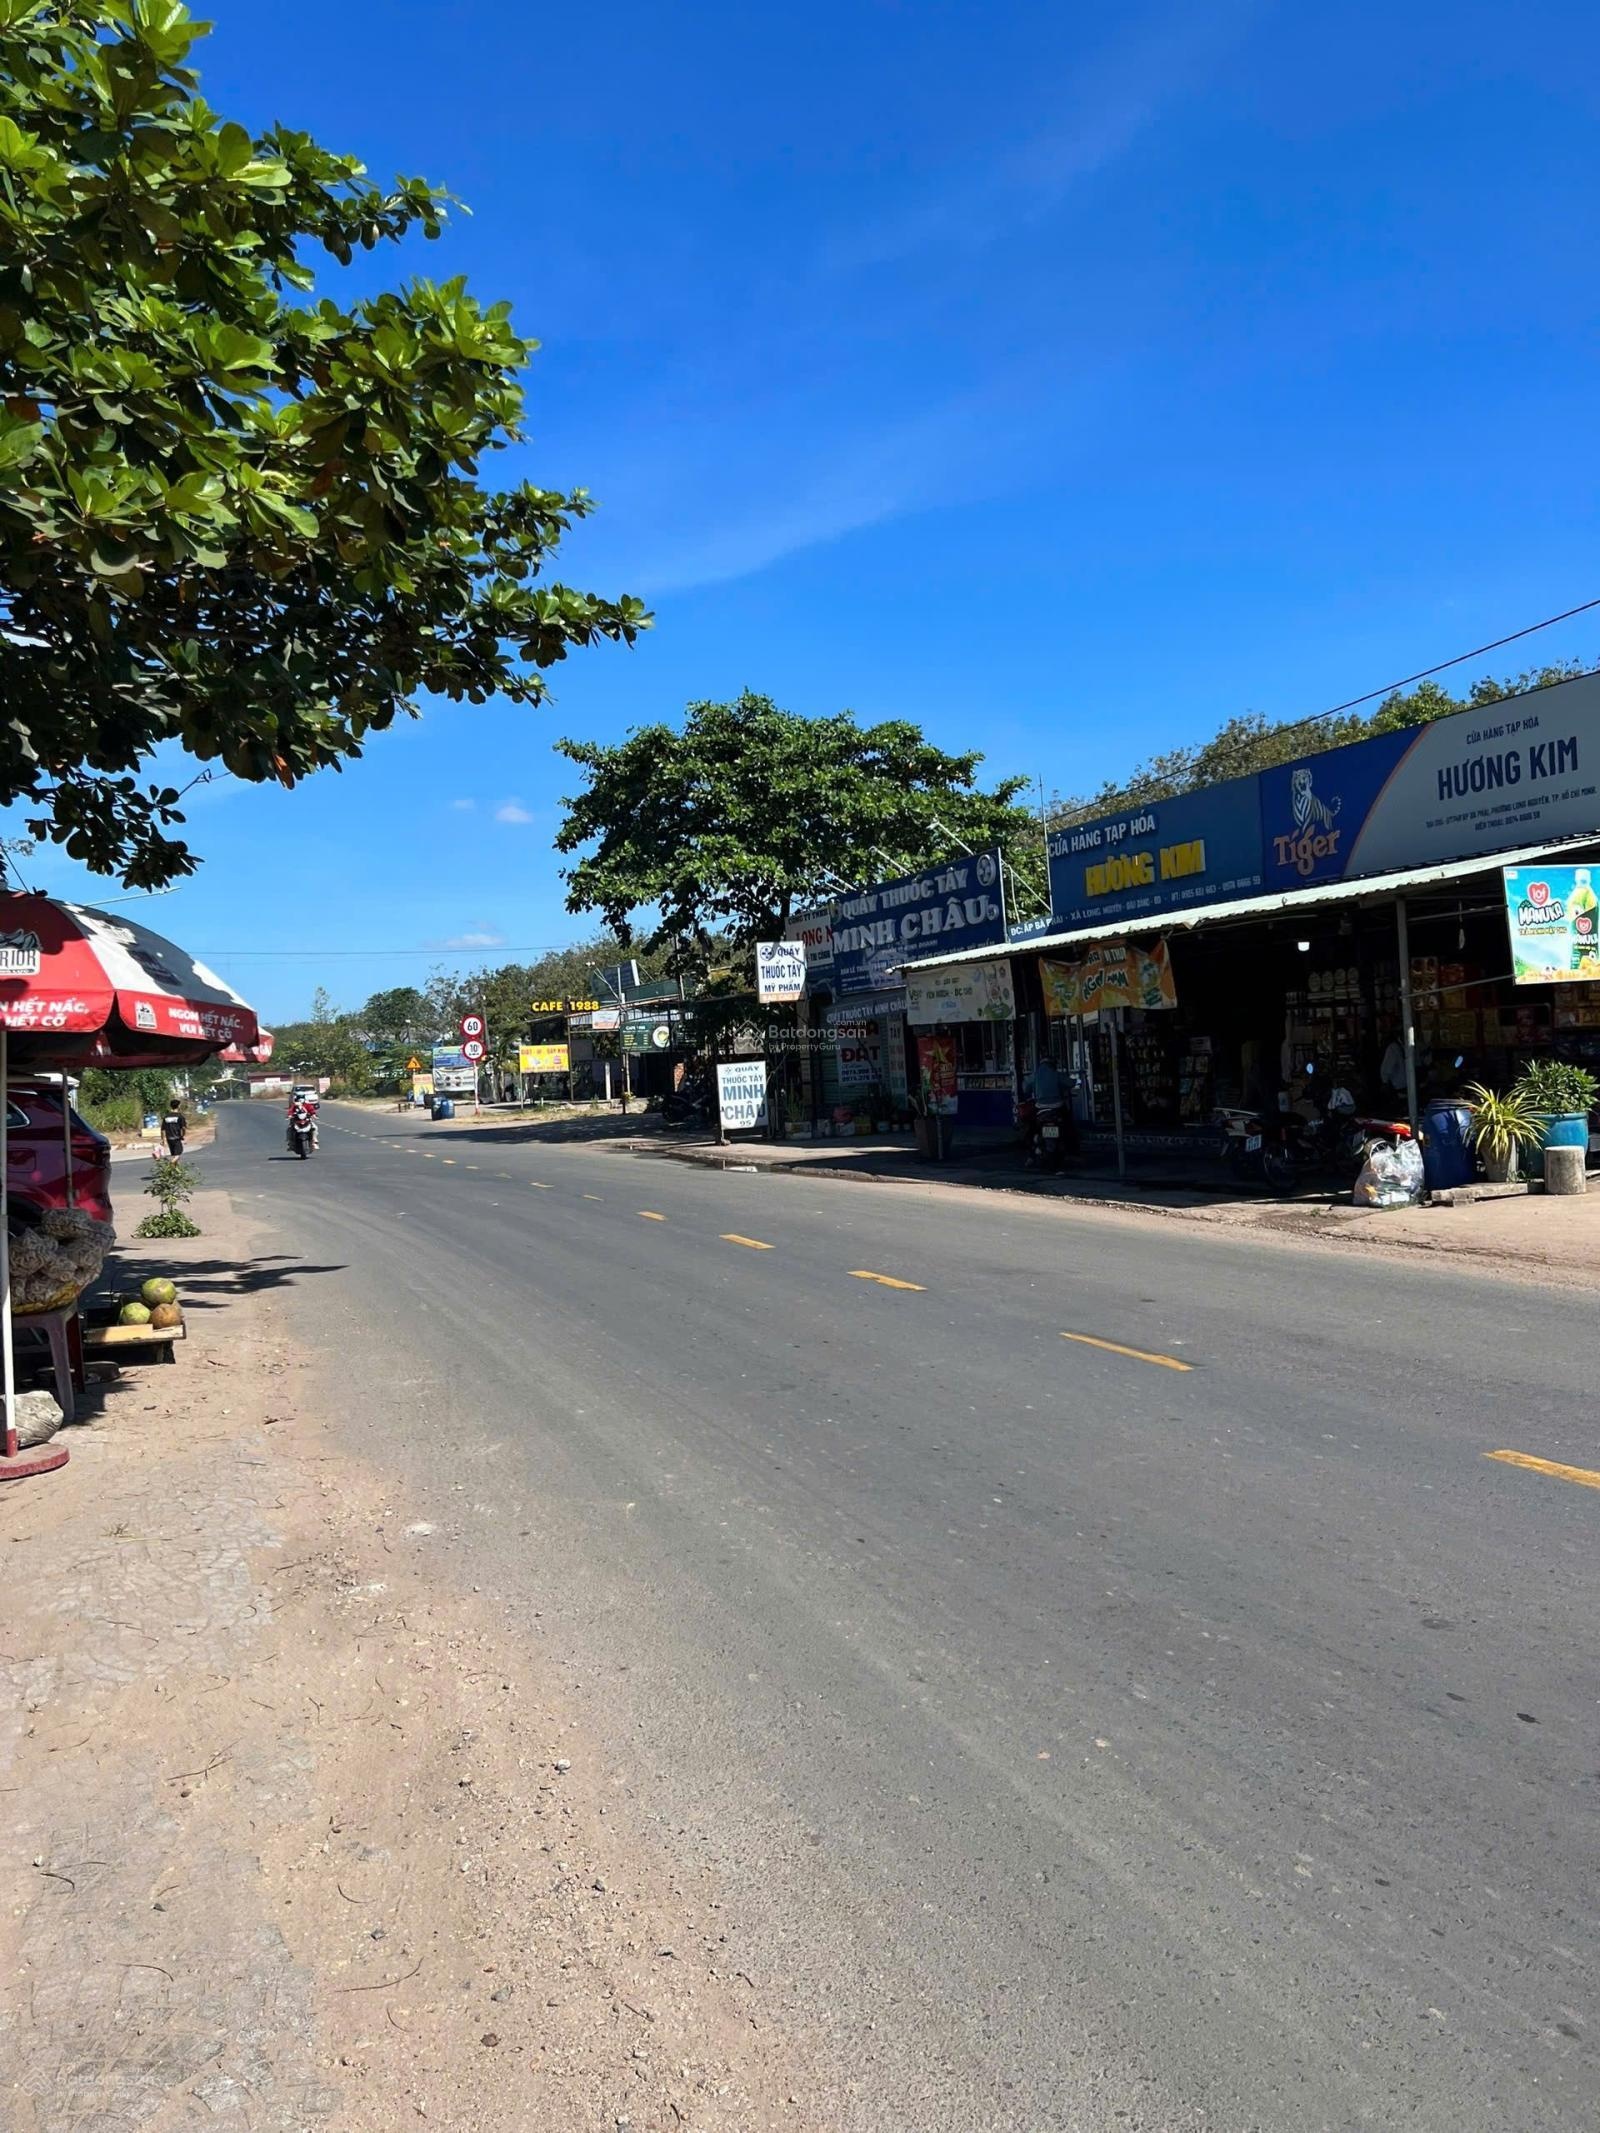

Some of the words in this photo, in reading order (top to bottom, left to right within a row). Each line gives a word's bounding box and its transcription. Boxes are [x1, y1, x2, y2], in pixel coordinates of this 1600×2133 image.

[1437, 750, 1521, 801] HƯƠNG
[1529, 736, 1578, 780] KIM
[1104, 822, 1127, 846] TẠP
[1273, 824, 1341, 876] Tiger
[1159, 839, 1207, 881] KIM
[879, 874, 935, 909] THUỐC
[934, 866, 969, 894] TÂY
[1518, 901, 1564, 926] MANUKA
[832, 918, 896, 954] MINH
[900, 894, 991, 940] CHÂU
[761, 960, 786, 979] THUỐC
[787, 961, 802, 978] TÂY
[12, 996, 47, 1013] HẾT
[531, 1001, 564, 1012] CAFE
[569, 1000, 600, 1011] 1988
[5, 1012, 39, 1028] HẾT
[168, 1007, 200, 1020] NGON
[200, 1010, 219, 1024] HẾT
[179, 1023, 197, 1035] VUI
[197, 1024, 216, 1038] HẾT
[467, 1021, 479, 1031] 60
[722, 1084, 764, 1101] MINH
[724, 1100, 766, 1120] CHÂU
